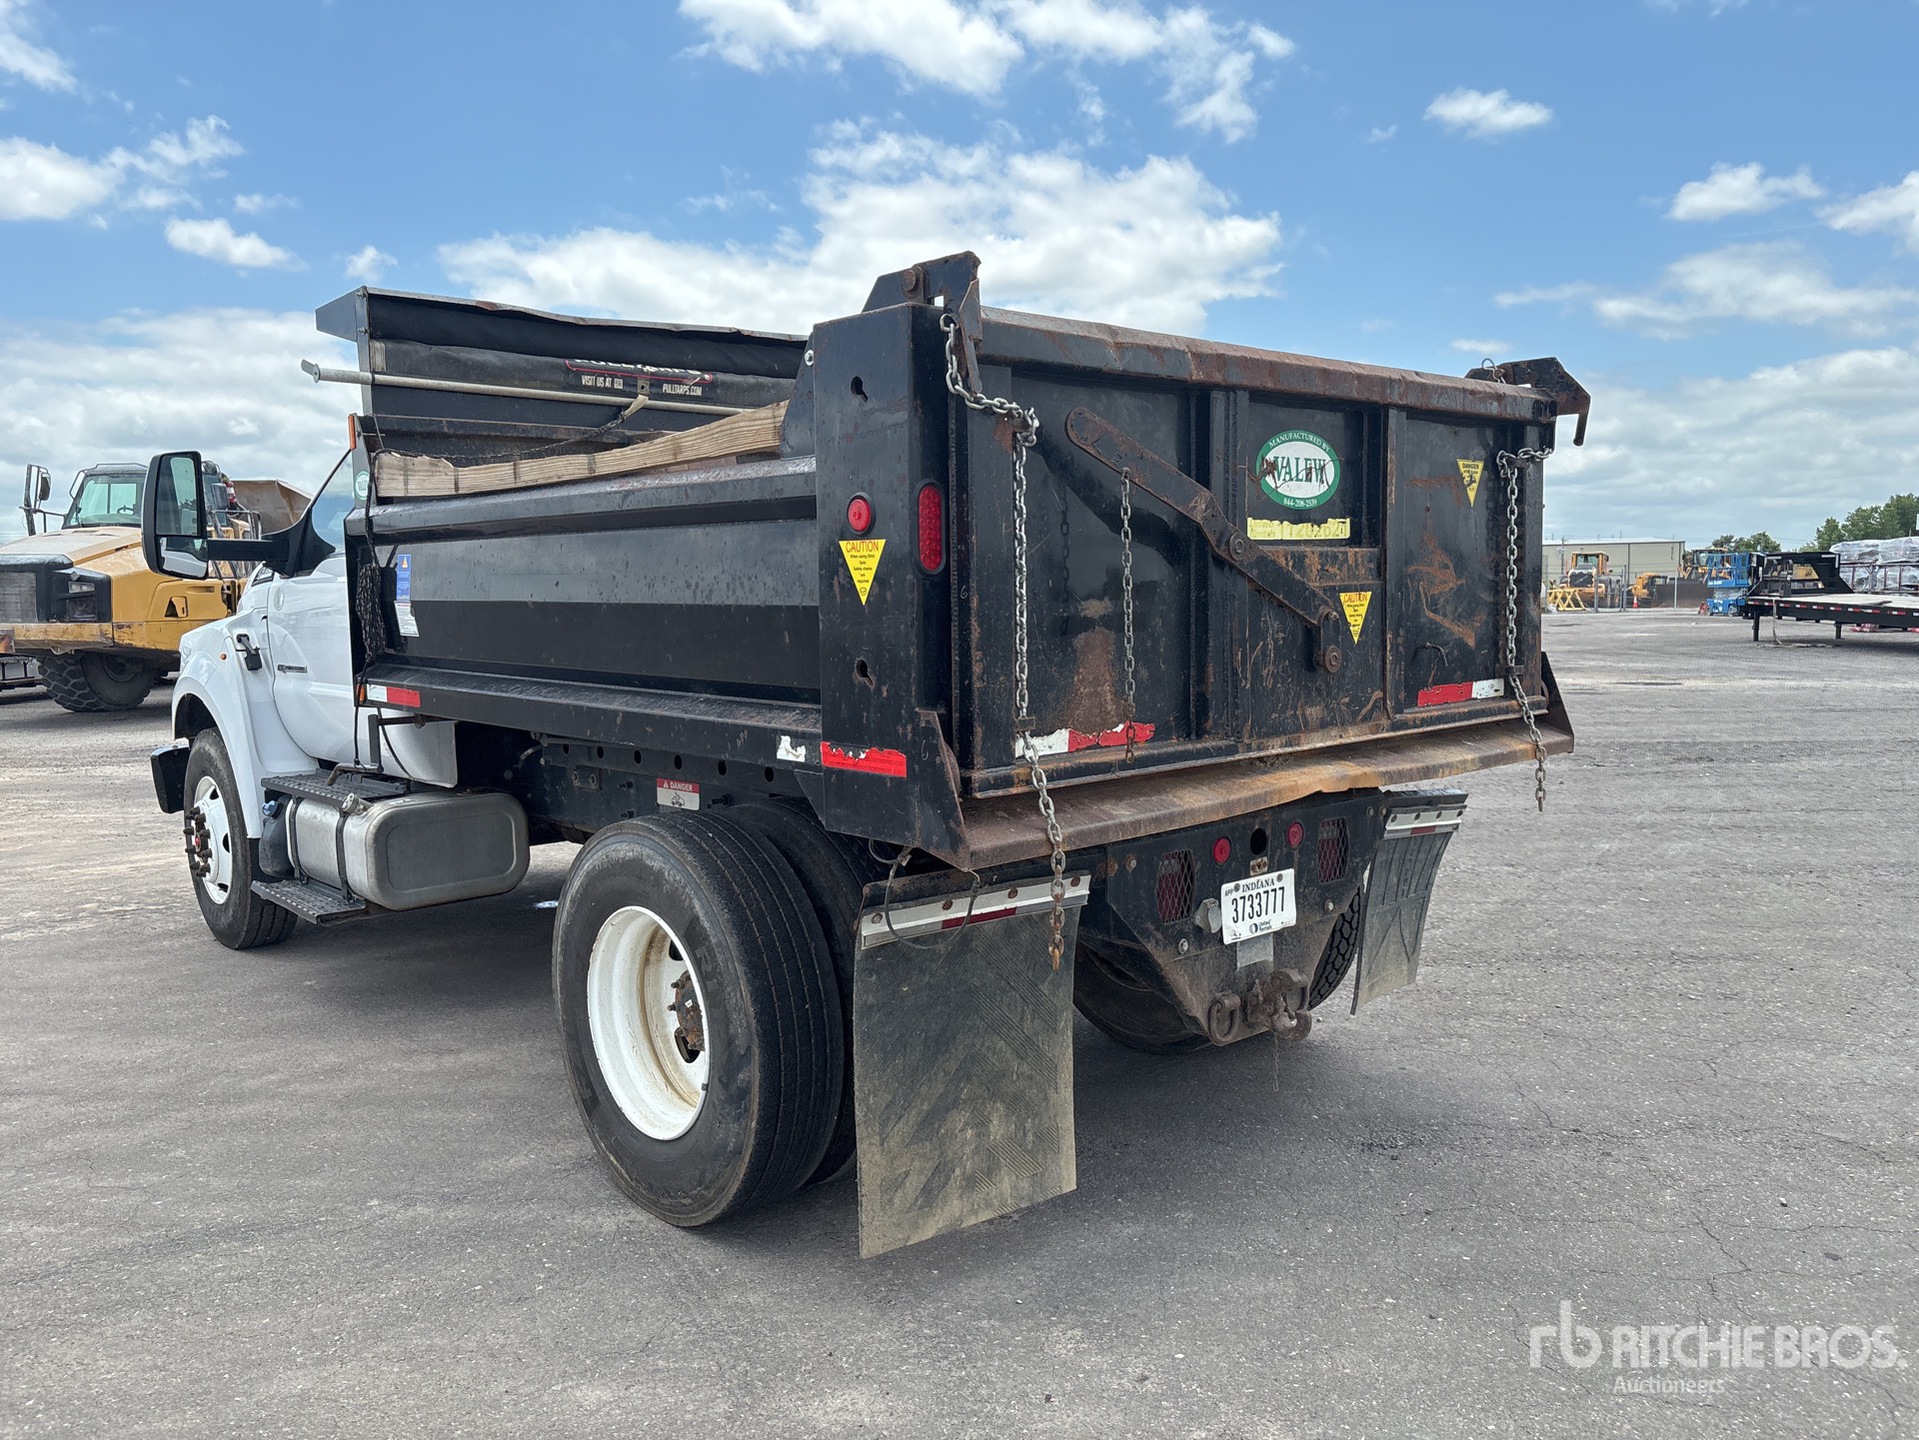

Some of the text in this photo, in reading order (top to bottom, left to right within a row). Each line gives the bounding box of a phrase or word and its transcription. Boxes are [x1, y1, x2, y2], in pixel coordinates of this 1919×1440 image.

[581, 374, 612, 388] VISIT US AT
[662, 383, 703, 396] PULLTARPS.COM
[1268, 432, 1331, 452] MANUFACTURED BY
[1273, 456, 1327, 482] VALEW
[845, 541, 879, 553] CAUTION
[670, 781, 694, 791] DANGER
[1242, 878, 1275, 893] INDIANA
[1231, 886, 1285, 924] 3733777
